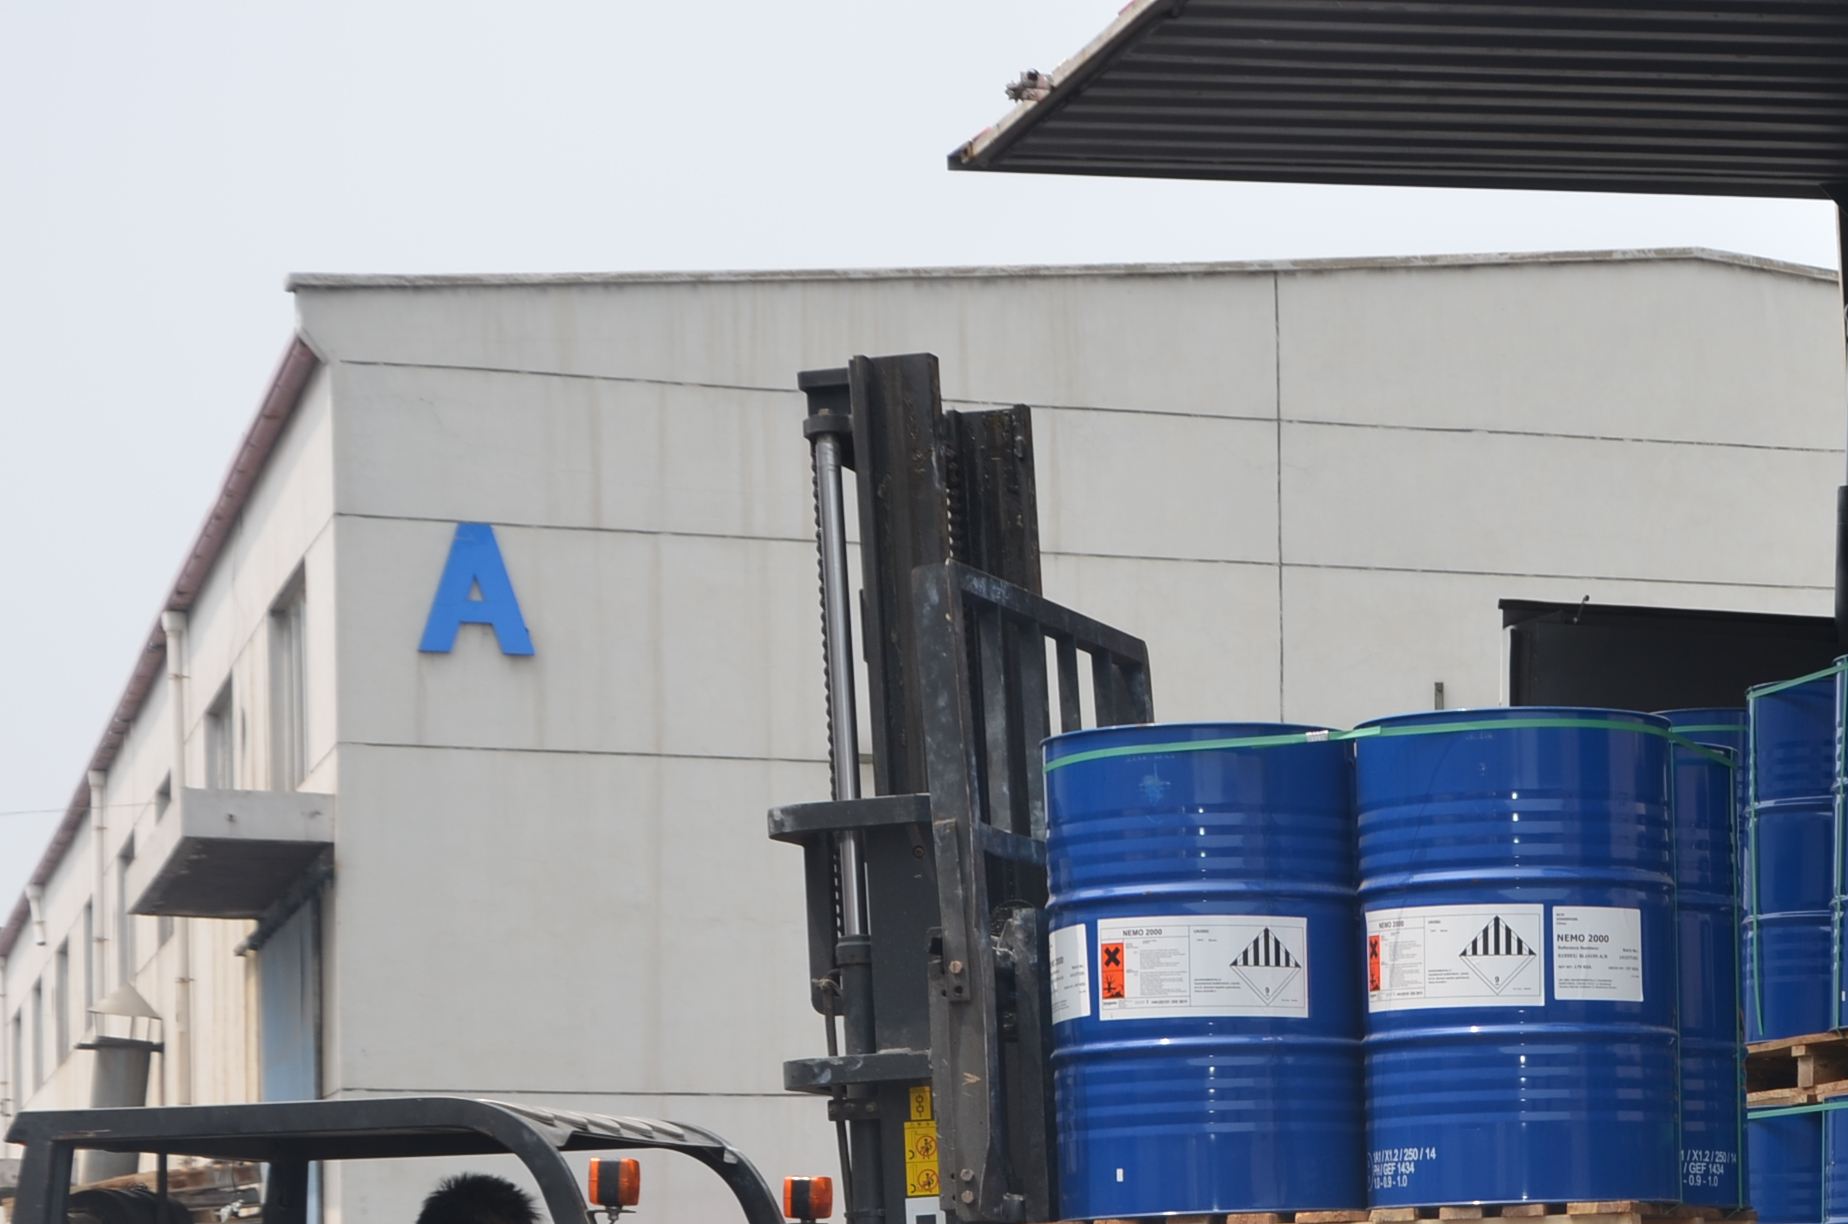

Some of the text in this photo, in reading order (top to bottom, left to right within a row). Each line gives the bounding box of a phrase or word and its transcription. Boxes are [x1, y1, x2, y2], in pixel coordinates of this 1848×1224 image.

[418, 521, 535, 657] A
[1122, 928, 1163, 937] NEMO 2000
[1556, 934, 1610, 943] NEMO 2000
[1404, 1147, 1418, 1161] 250
[1425, 1147, 1436, 1160] 14
[1383, 1163, 1396, 1175] GEF
[1397, 1162, 1415, 1174] 1434
[1688, 1162, 1707, 1174] GEF
[1397, 1175, 1408, 1187] 1.0
